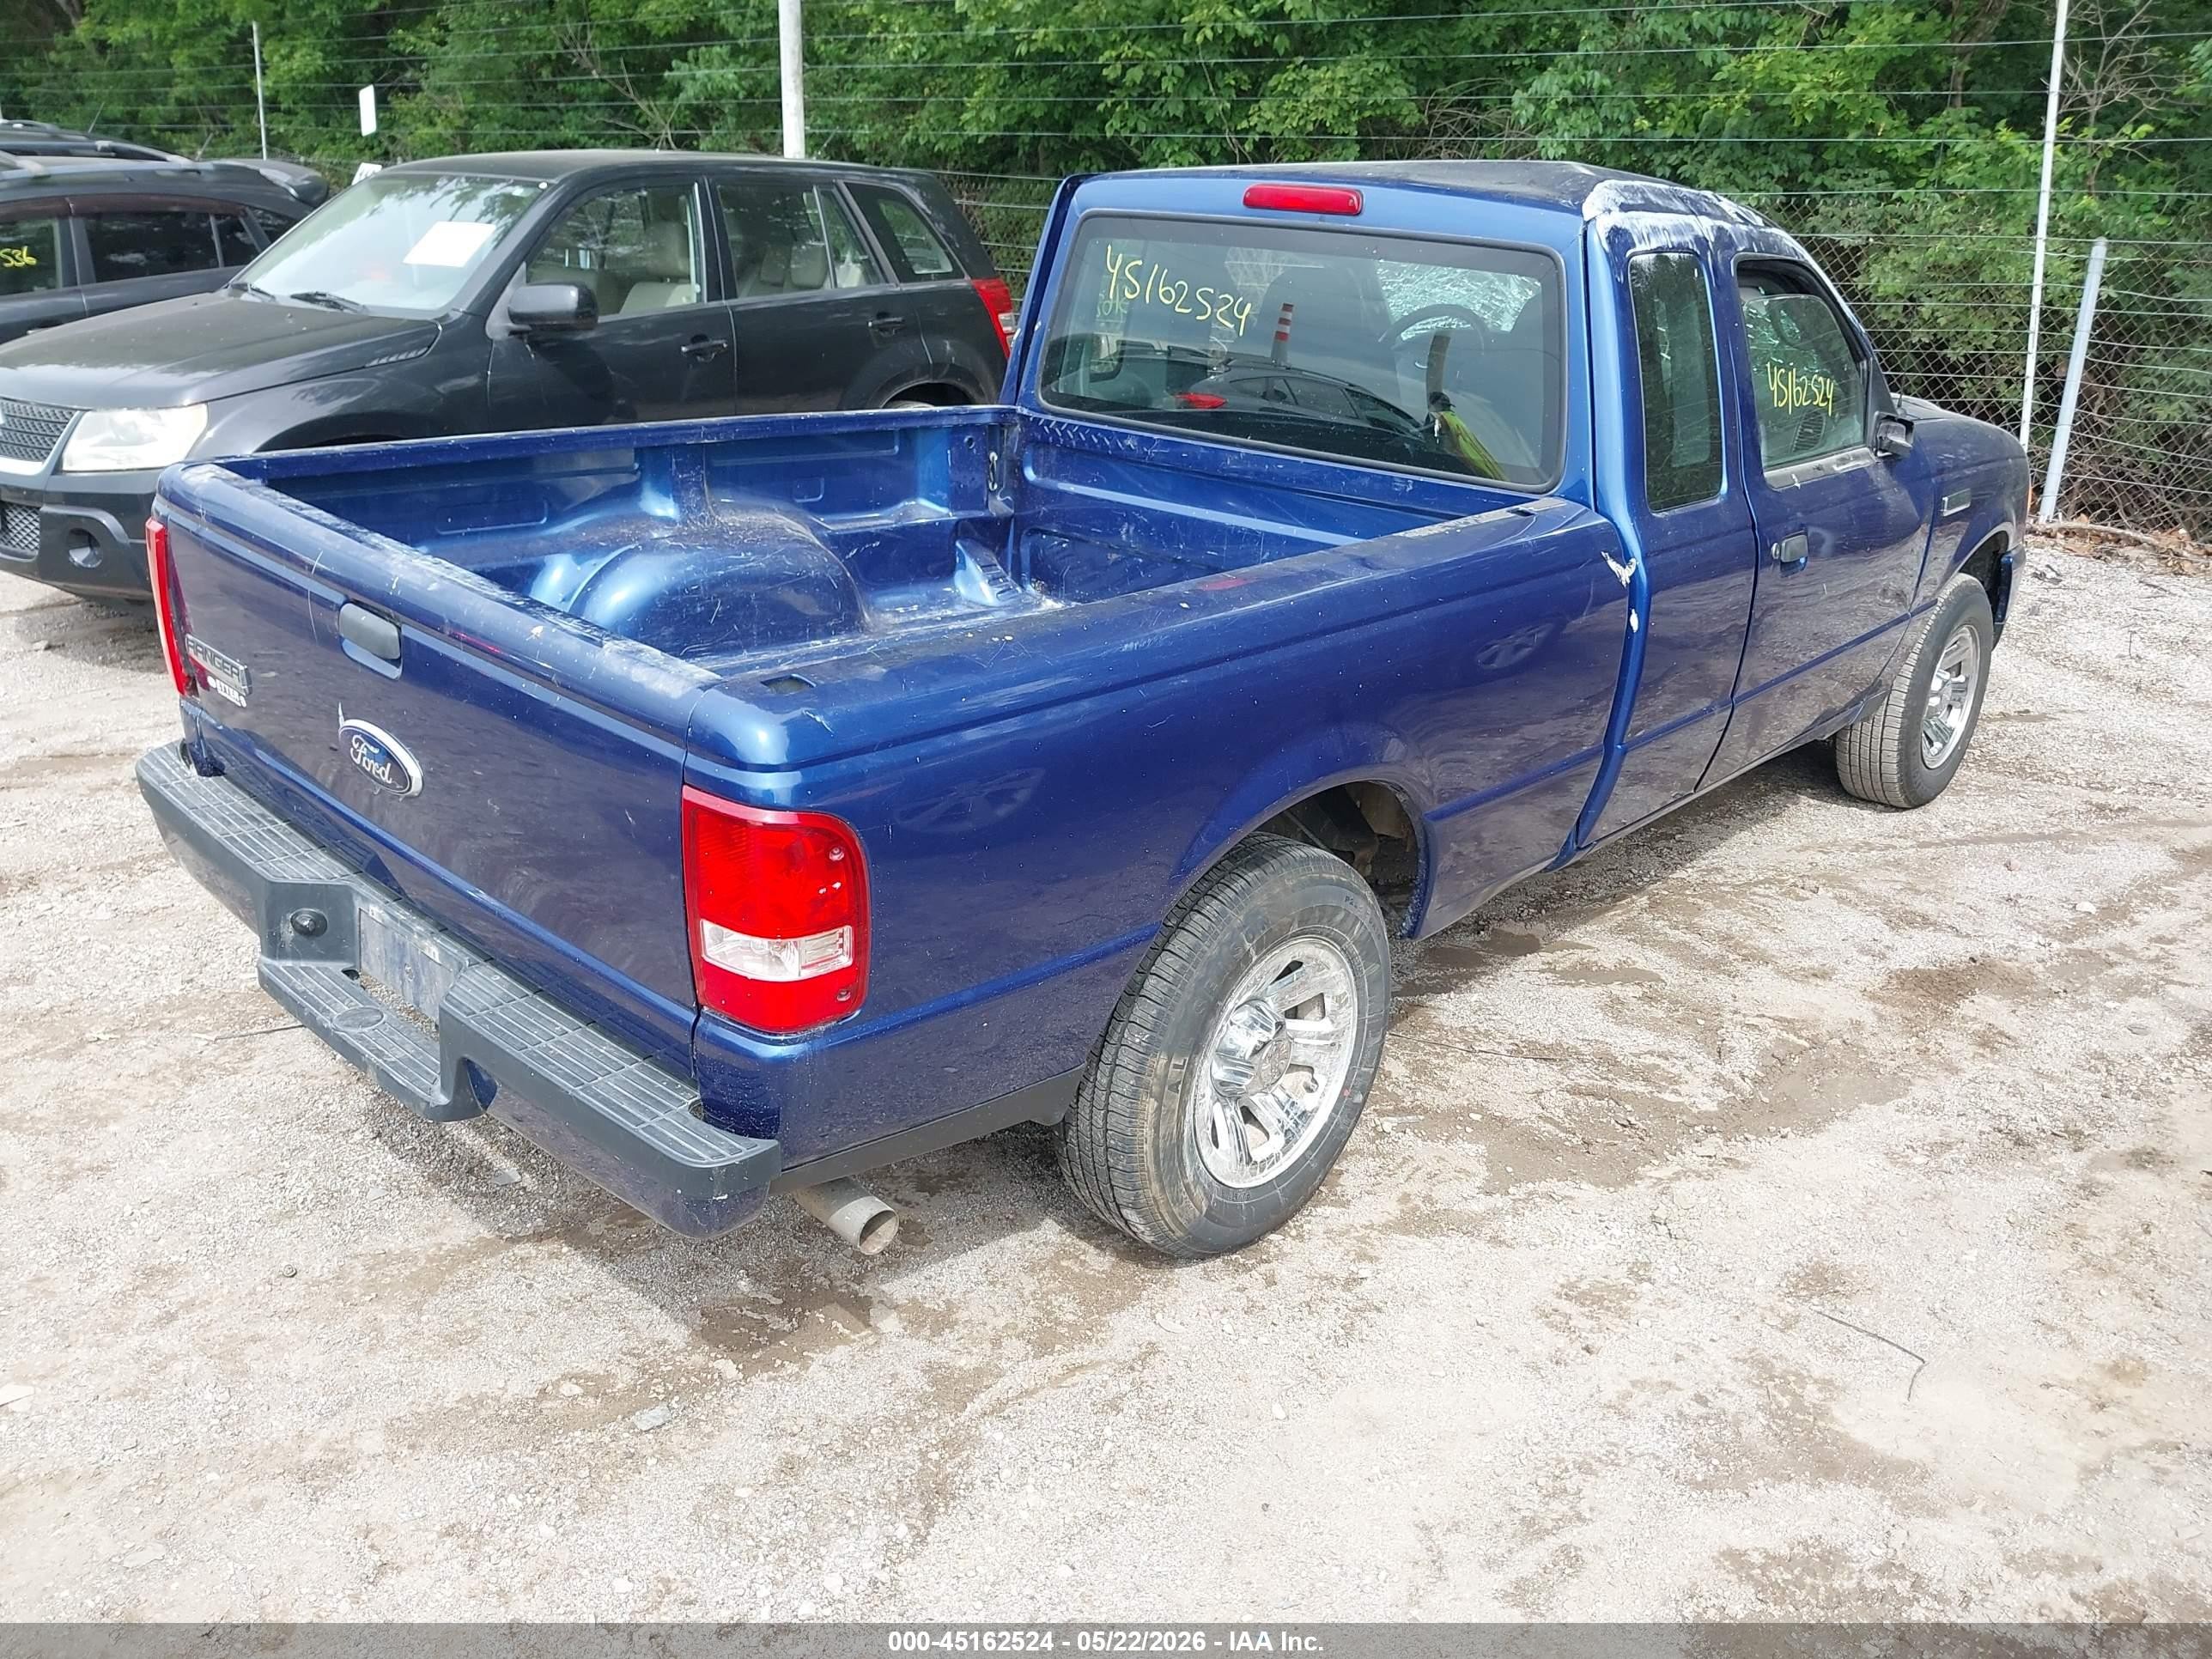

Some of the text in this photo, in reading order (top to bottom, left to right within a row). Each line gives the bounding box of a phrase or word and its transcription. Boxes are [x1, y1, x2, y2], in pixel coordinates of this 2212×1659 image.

[1106, 244, 1252, 337] 45162524
[1765, 362, 1834, 416] 45162524
[186, 637, 241, 684] RANGER
[349, 734, 392, 784] Ford
